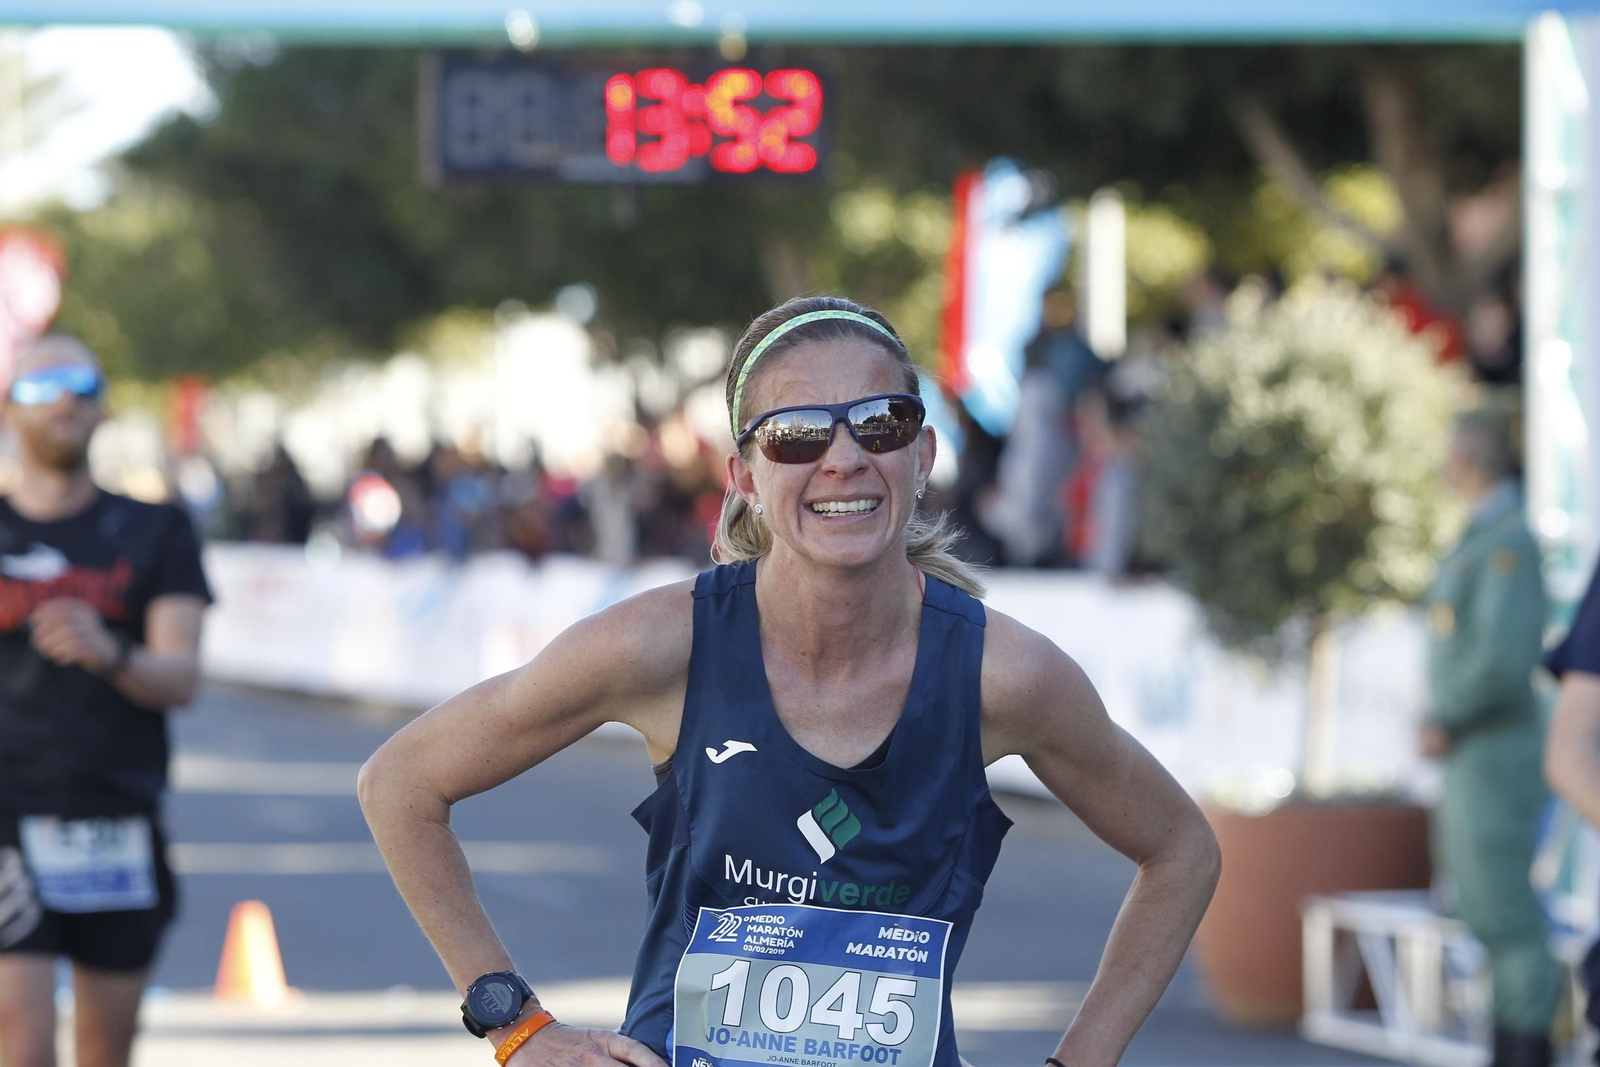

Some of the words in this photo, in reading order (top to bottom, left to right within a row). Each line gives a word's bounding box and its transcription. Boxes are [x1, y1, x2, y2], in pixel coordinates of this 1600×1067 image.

[725, 854, 910, 907] Murgiverde
[746, 924, 804, 938] MARATÓN
[877, 926, 930, 944] MEDIO
[742, 944, 786, 955] 03/02/2019
[744, 934, 795, 949] ALMERÍA
[845, 942, 928, 963] MARATÓN
[710, 958, 916, 1046] 1045
[499, 1027, 529, 1060] ALTEA
[706, 1026, 797, 1054] JO-ANNE
[803, 1038, 902, 1066] BARFOOT
[766, 1055, 800, 1065] JO-ANNE
[801, 1059, 837, 1067] BARFOOT
